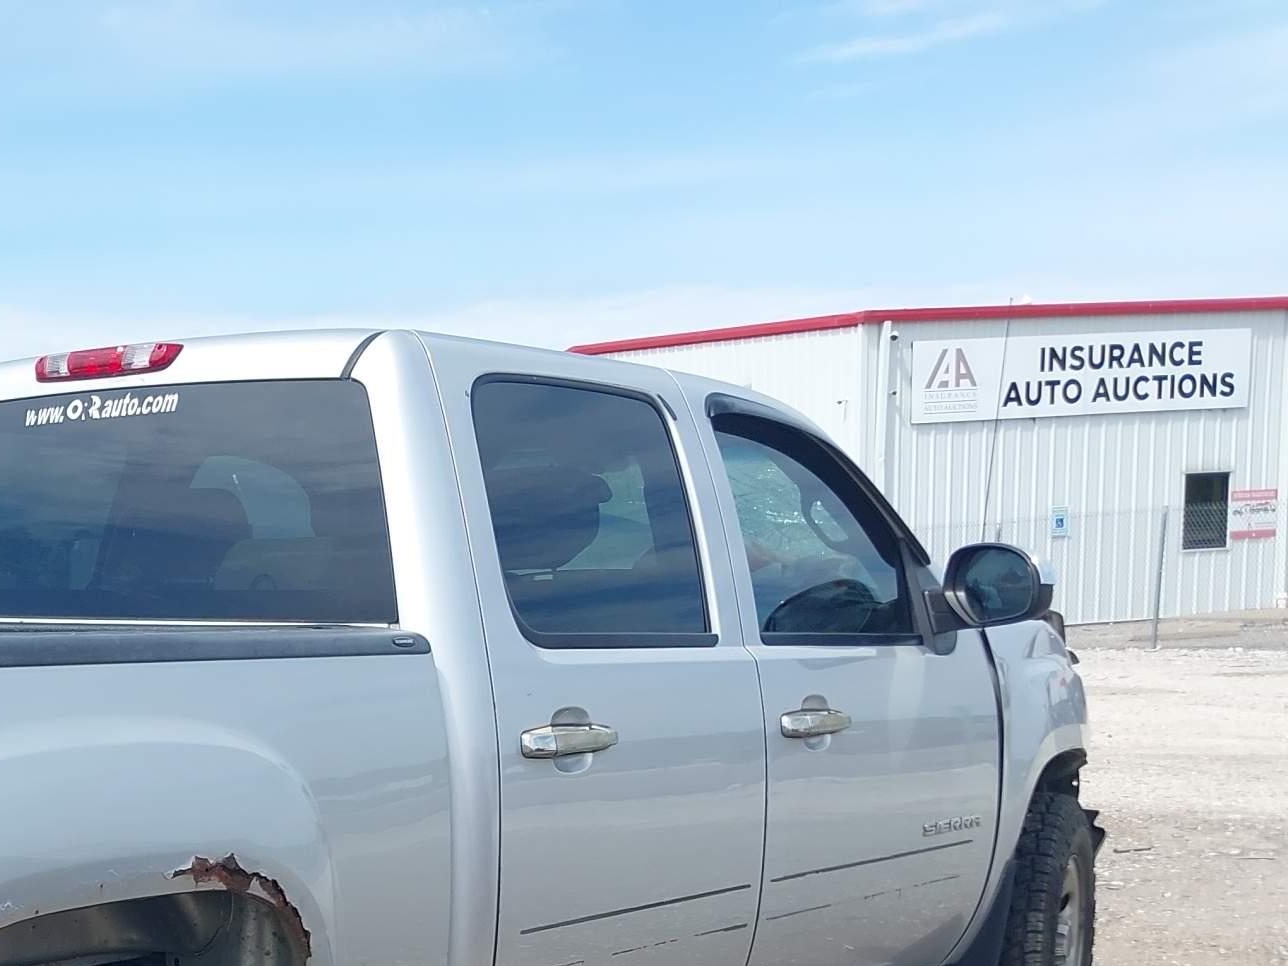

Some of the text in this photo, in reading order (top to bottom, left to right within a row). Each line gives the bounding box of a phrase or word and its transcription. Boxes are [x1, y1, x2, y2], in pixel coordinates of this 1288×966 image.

[1039, 340, 1204, 373] INSURANCE
[1002, 372, 1235, 408] AUTO AUCTIONS
